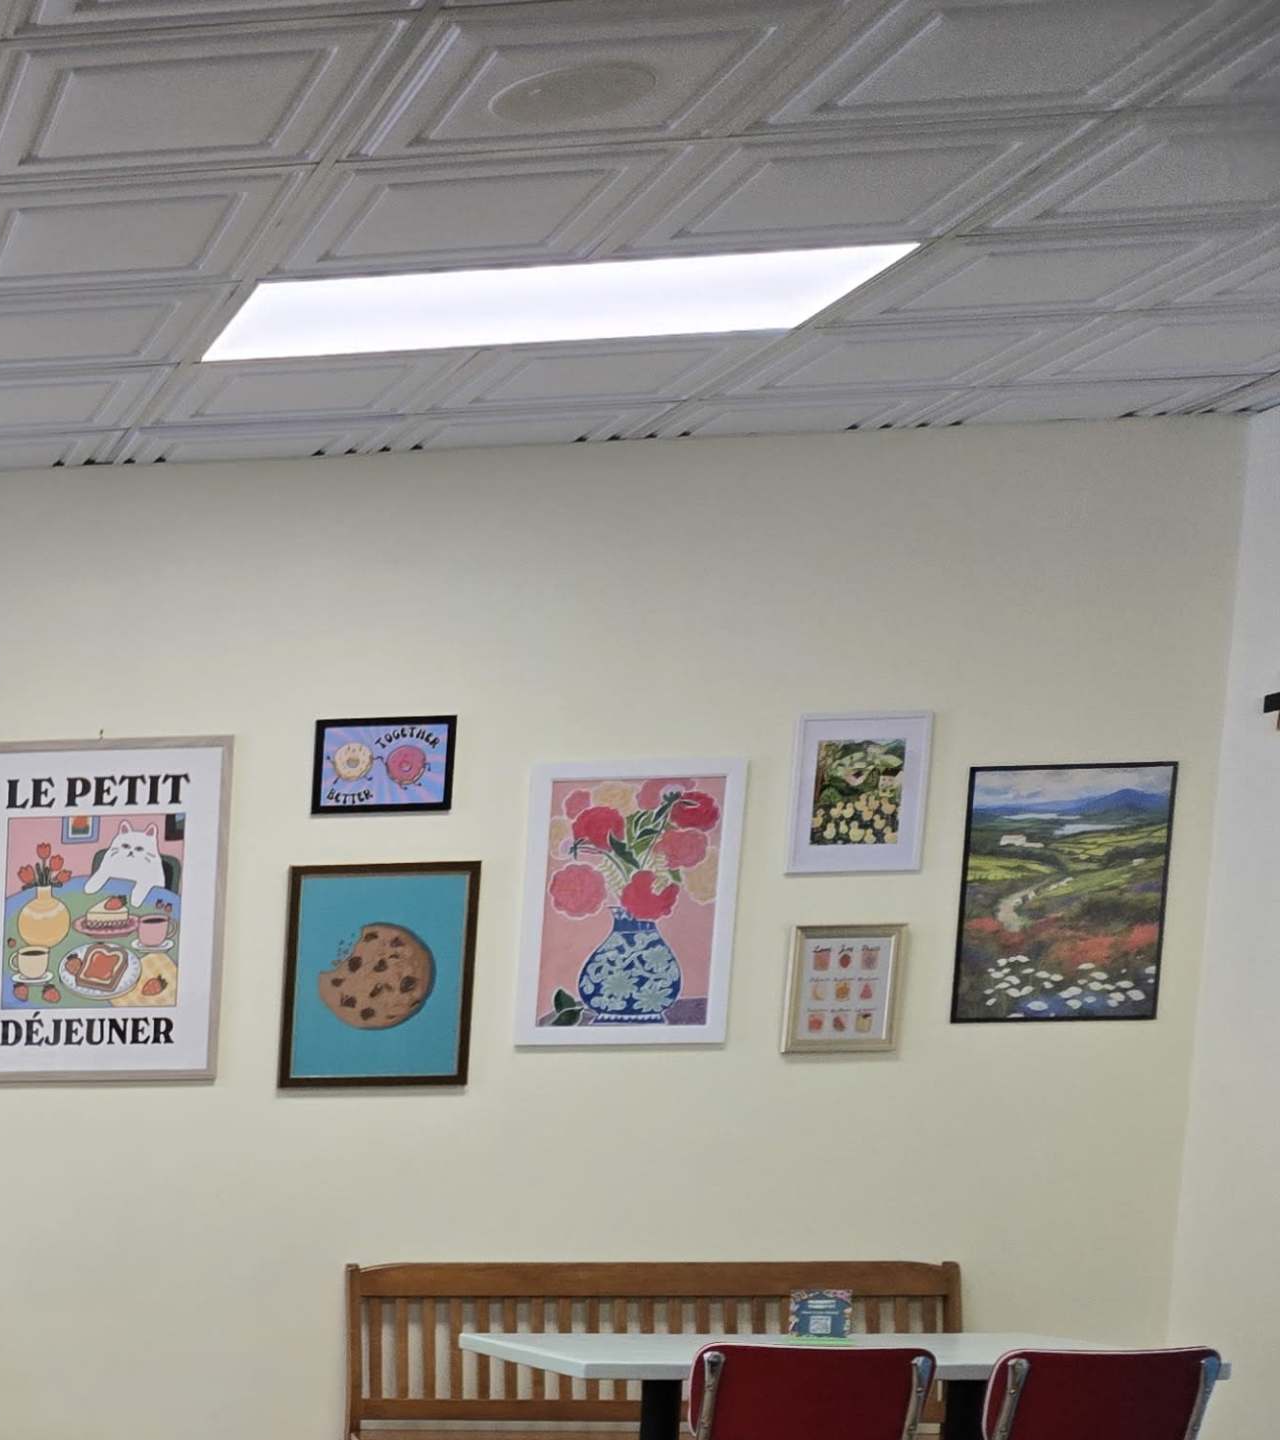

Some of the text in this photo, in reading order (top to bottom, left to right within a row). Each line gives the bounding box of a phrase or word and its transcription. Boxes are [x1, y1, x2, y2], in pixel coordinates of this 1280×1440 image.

[375, 726, 440, 749] TOGETHER
[6, 773, 191, 809] LE PETIT
[326, 788, 374, 804] BETTER
[0, 1011, 175, 1046] DÉJEUNER
